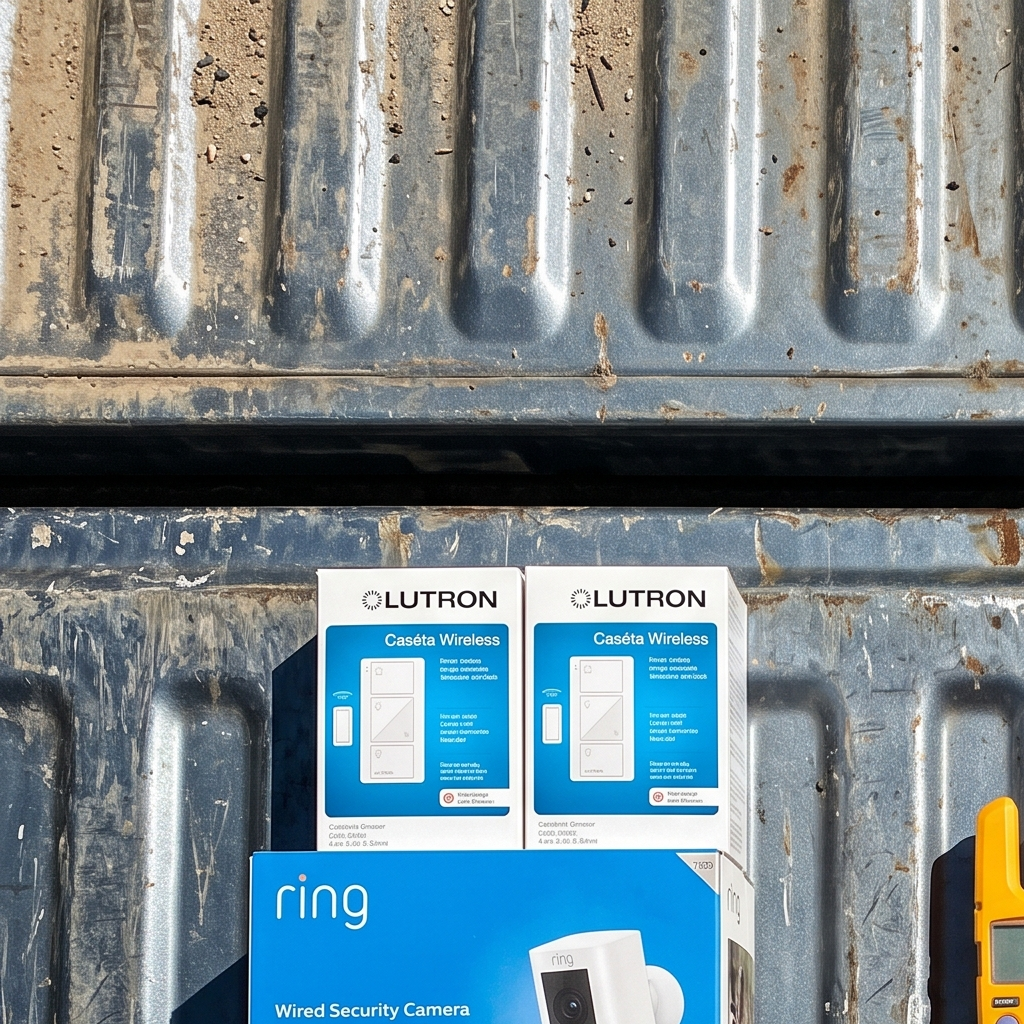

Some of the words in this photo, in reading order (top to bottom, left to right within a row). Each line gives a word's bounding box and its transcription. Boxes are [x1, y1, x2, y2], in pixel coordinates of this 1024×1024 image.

[385, 590, 497, 609] LUTRON
[593, 589, 706, 608] LUTRON
[385, 633, 435, 647] Caséta
[439, 633, 500, 647] Wireless
[593, 632, 644, 645] Caséta
[648, 632, 709, 645] Wireless
[276, 873, 369, 930] ring
[552, 952, 574, 968] ring
[275, 1003, 325, 1018] Wired
[329, 1003, 399, 1021] Security
[403, 1002, 471, 1017] Camera
